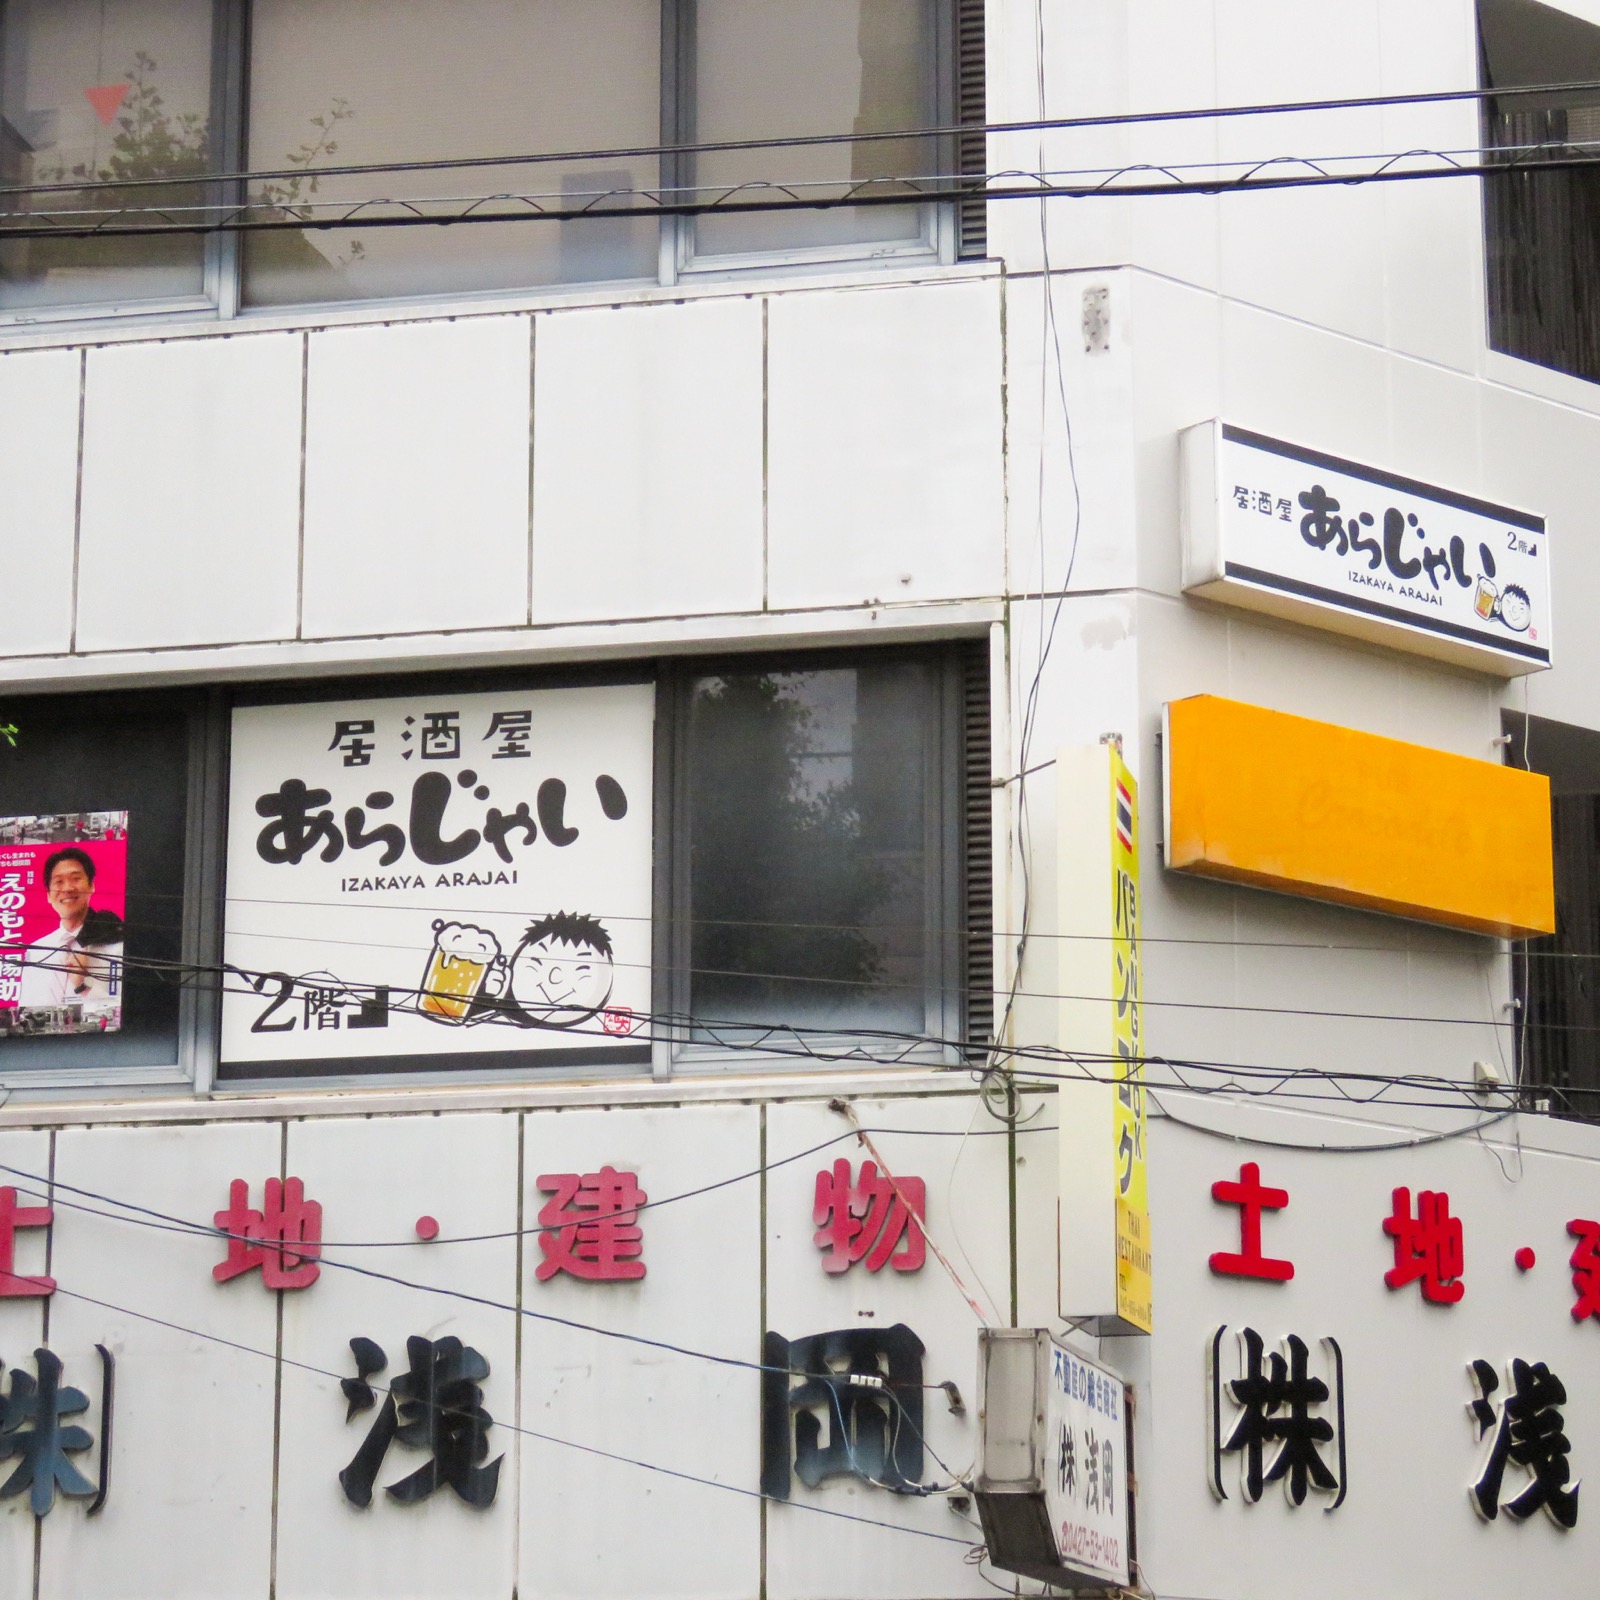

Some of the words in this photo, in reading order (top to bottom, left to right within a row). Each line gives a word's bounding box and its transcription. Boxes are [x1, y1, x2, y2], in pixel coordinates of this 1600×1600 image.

[1232, 485, 1292, 523] 居酒屋
[1298, 484, 1496, 590] あらじゃい
[1348, 570, 1394, 593] IZAKAYA
[1399, 585, 1443, 607] ARAJAI
[328, 710, 533, 767] 居酒屋
[255, 769, 628, 867] あらじゃい
[341, 875, 426, 892] IZAKAYA
[435, 870, 518, 888] ARAJAI
[251, 971, 347, 1033] 2階
[1129, 880, 1142, 1160] BANGKOK
